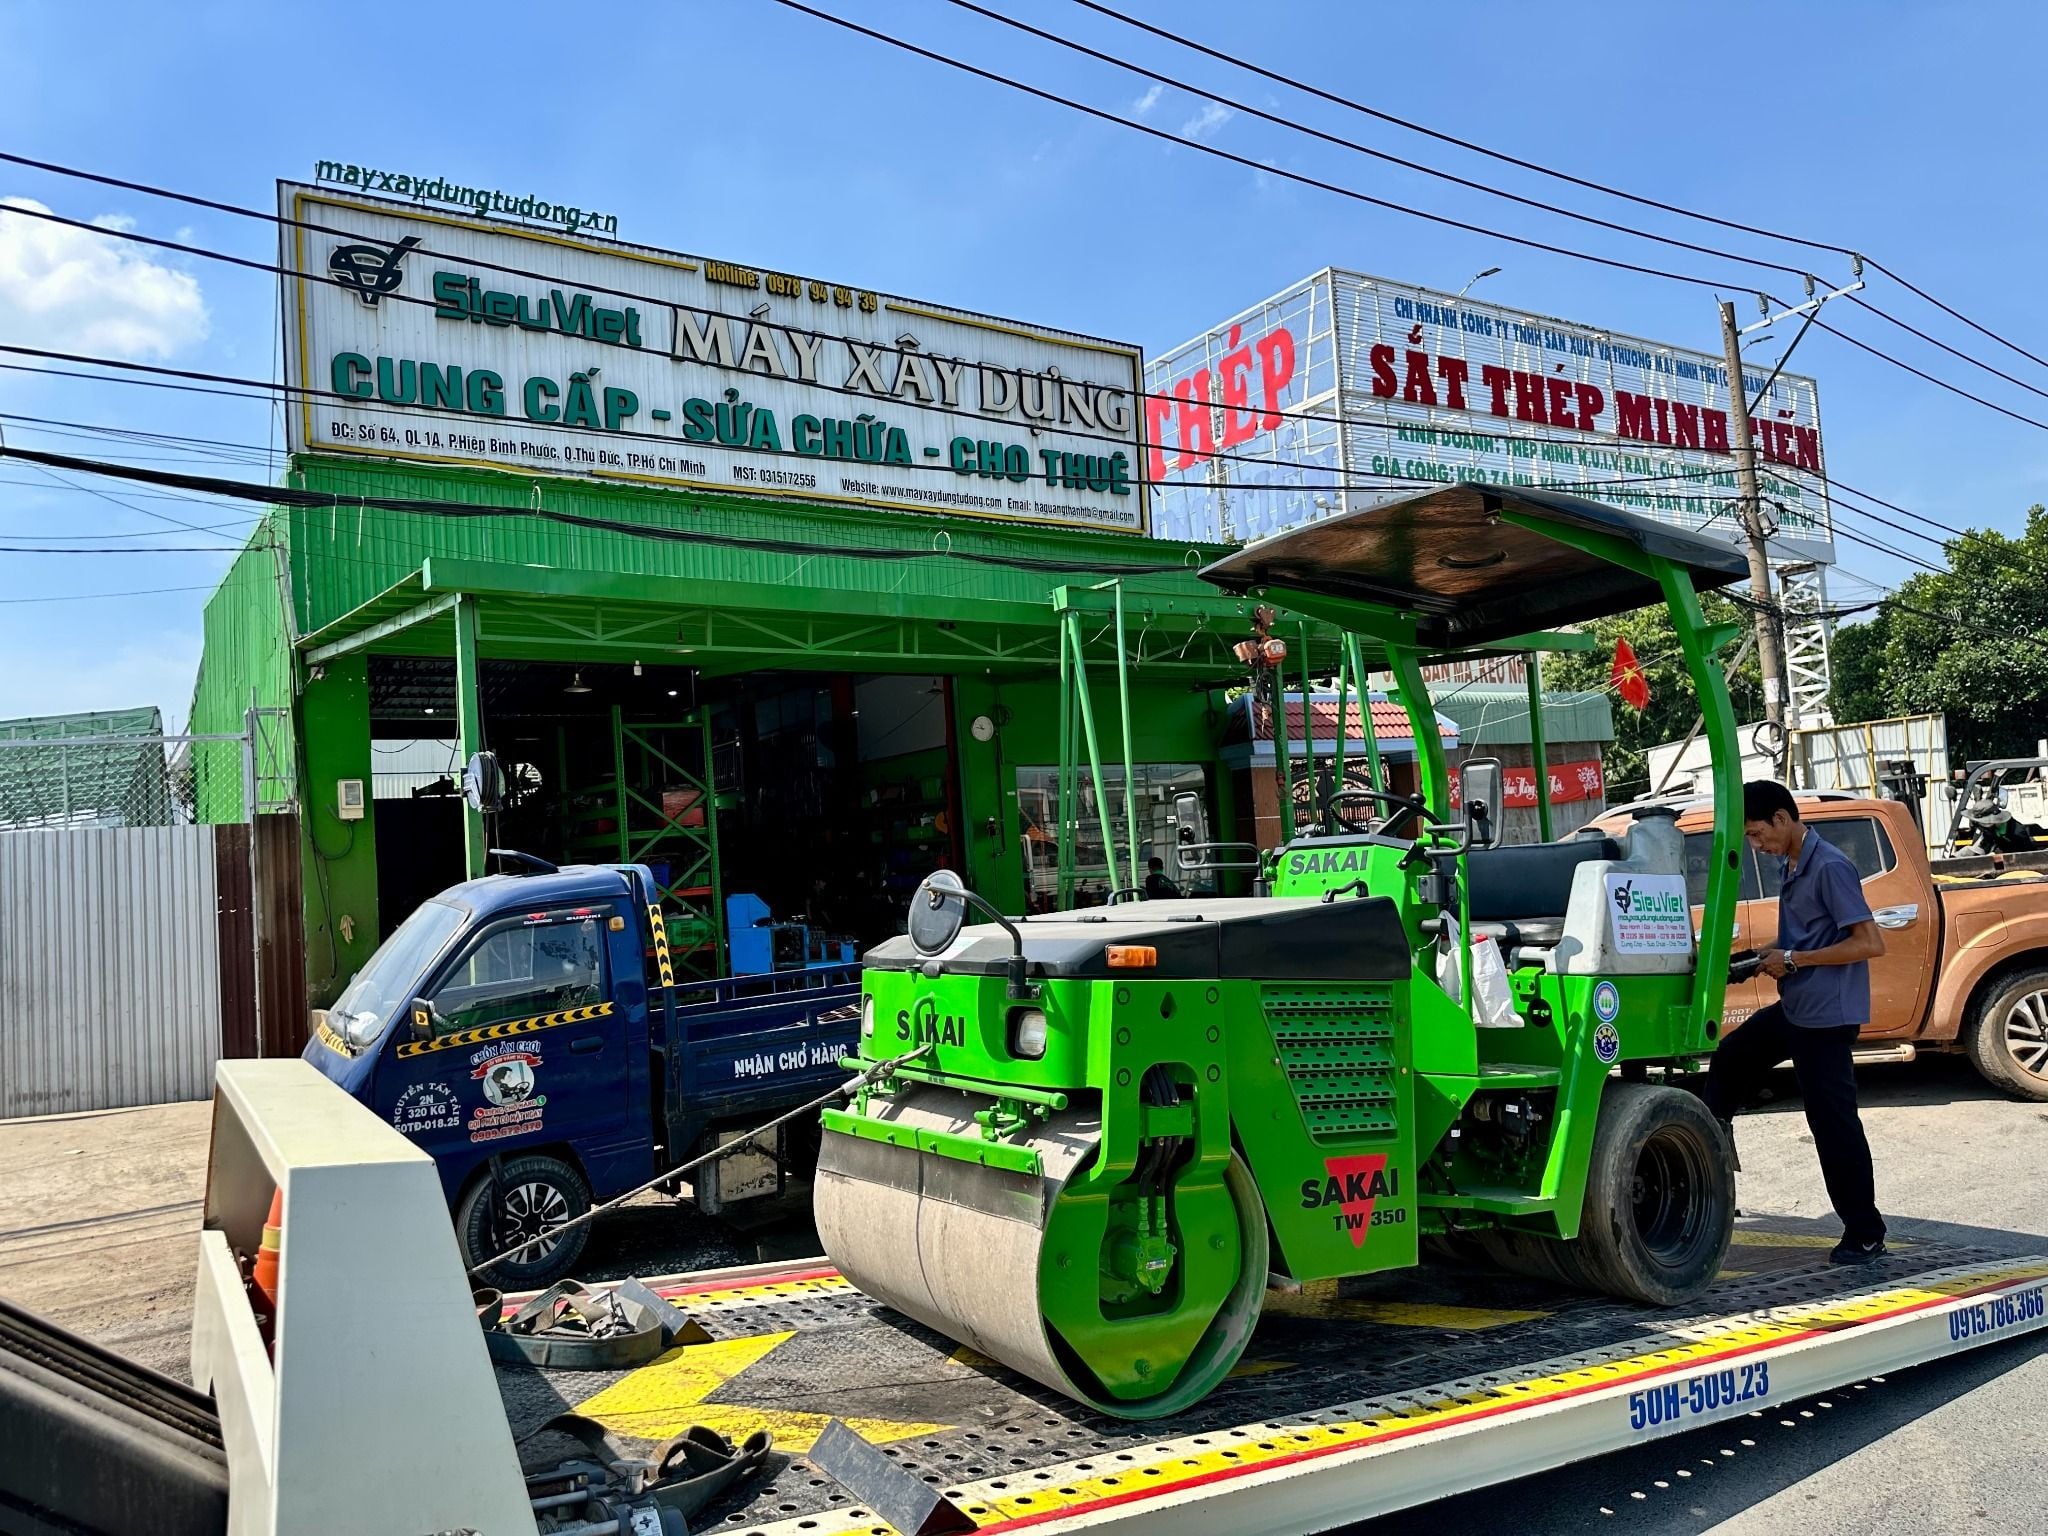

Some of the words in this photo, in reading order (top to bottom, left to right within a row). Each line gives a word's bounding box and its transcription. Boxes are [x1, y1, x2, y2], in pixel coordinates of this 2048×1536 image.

[704, 261, 760, 291] Hotline:
[766, 273, 801, 298] 0978
[809, 280, 828, 303] 94
[834, 286, 853, 309] 94
[858, 291, 878, 313] 39
[433, 271, 642, 346] SieuViet
[1394, 297, 1412, 320] CHI
[1494, 319, 1508, 340] TY
[1513, 323, 1542, 347] TNHH
[670, 302, 825, 384] MÁY
[842, 332, 967, 407] XÂY
[976, 362, 1131, 437] DỰNG
[1370, 324, 1468, 410] SẮT
[1482, 363, 1605, 432] THÉP
[1615, 390, 1731, 455] MINH
[331, 352, 505, 415] CUNG
[523, 367, 640, 430] CẤP
[682, 387, 783, 452] SỬA
[792, 414, 913, 465] CHỮA
[950, 435, 1030, 483] CHO
[1038, 448, 1131, 496] THUÊ
[1397, 421, 1436, 445] KINH
[331, 421, 355, 439] ĐC:
[358, 423, 377, 441] Số
[380, 427, 400, 444] 64,
[405, 430, 421, 445] QL
[424, 432, 444, 448] 1A,
[449, 433, 486, 453] P.Hiệp
[520, 441, 560, 460] Phước,
[564, 446, 595, 463] Q.Thủ
[599, 449, 624, 468] Đức,
[659, 456, 676, 472] Chí
[680, 459, 706, 475] Minh
[1372, 455, 1400, 476] GIA
[733, 465, 757, 481] MST:
[760, 469, 816, 488] 0315172556
[841, 477, 879, 495] Website:
[881, 484, 1002, 508] www.mayxaydungtudong.com
[1007, 497, 1032, 511] Email:
[1288, 849, 1369, 876] SAKAI
[1631, 889, 1684, 913] SieuViet
[734, 1053, 774, 1079] NHẬN
[779, 1041, 807, 1071] CHỞ
[408, 1107, 427, 1119] 320
[430, 1104, 446, 1116] KG
[419, 1094, 434, 1106] 2N
[1301, 1167, 1399, 1209] SAKAI
[1333, 1212, 1365, 1232] TW
[1371, 1208, 1406, 1227] 350
[1949, 1285, 2045, 1341] 0915.786.366
[1629, 1361, 1770, 1431] 50H-509.23
